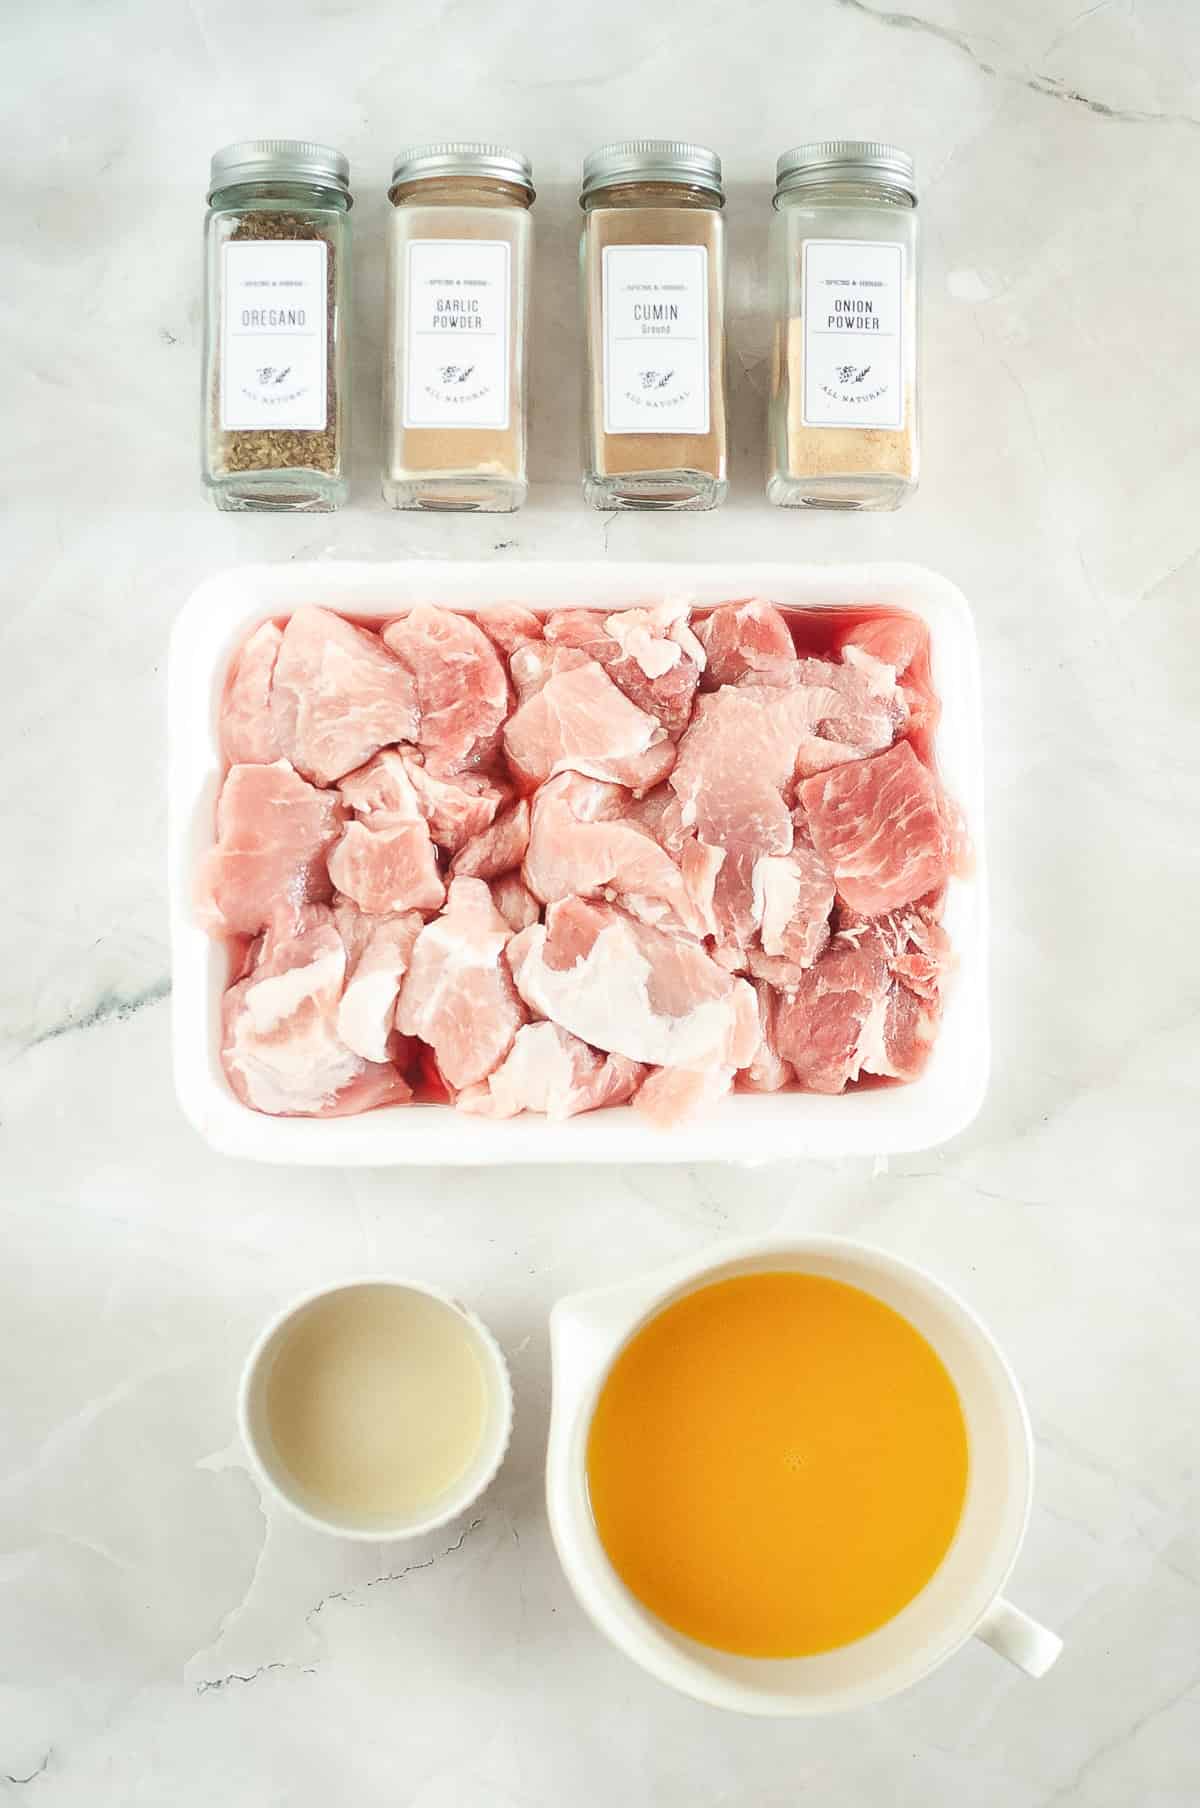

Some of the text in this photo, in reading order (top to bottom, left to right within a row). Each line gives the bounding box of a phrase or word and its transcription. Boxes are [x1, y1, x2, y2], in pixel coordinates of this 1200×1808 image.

[436, 299, 479, 313] GARLIC
[633, 304, 678, 321] CUMIN
[834, 299, 873, 313] ONION
[242, 309, 306, 327] OREGANO
[432, 315, 482, 329] POWDER
[828, 315, 880, 330] POWDER
[641, 323, 671, 334] Ground
[842, 385, 888, 403] NATURAL
